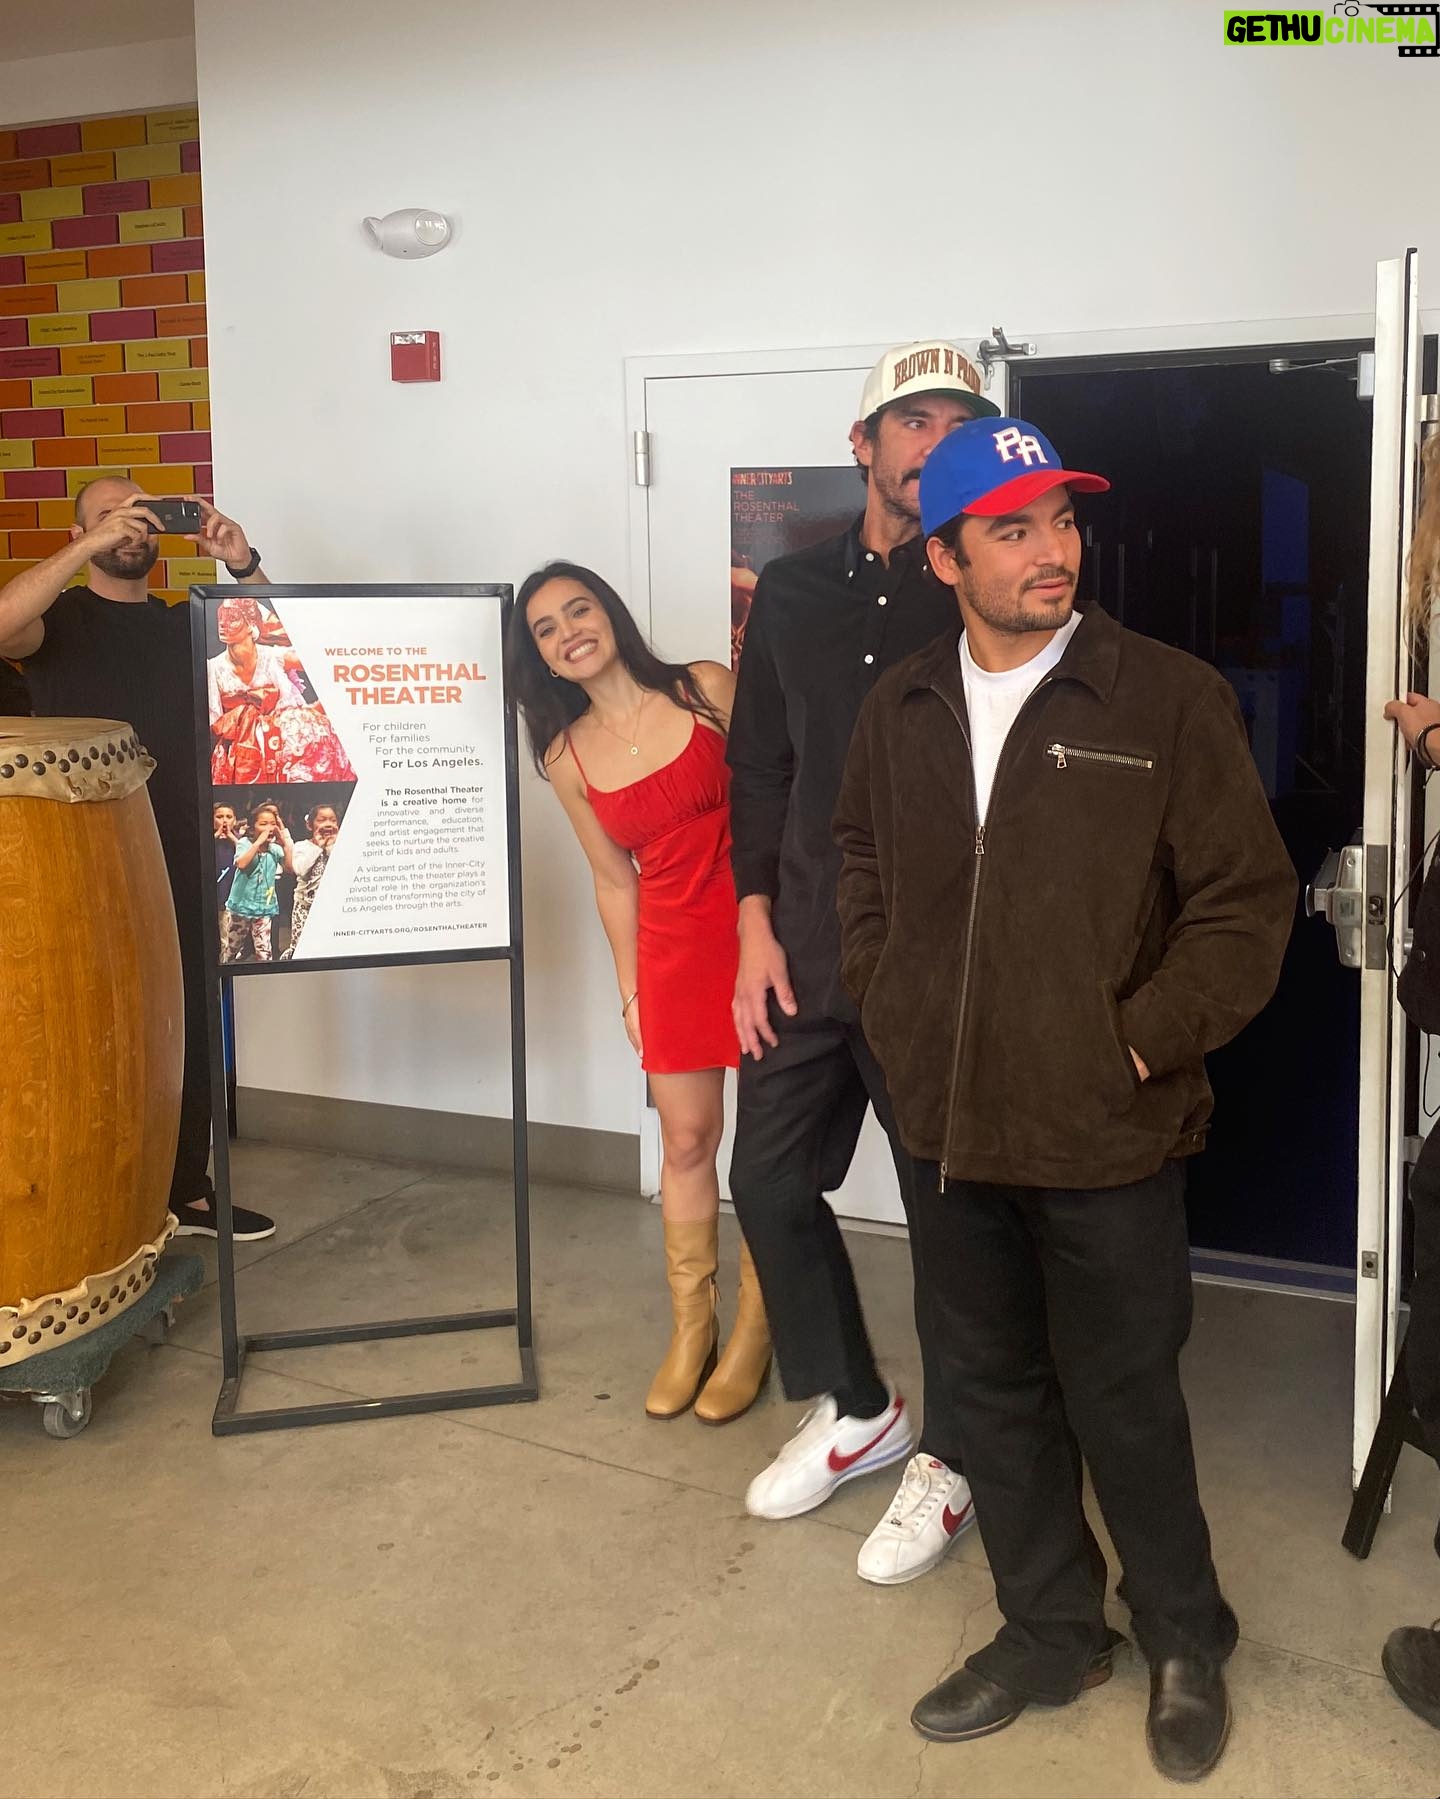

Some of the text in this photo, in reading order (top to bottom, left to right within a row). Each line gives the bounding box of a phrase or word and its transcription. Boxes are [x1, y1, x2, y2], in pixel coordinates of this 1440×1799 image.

[893, 348, 940, 391] BROWN
[944, 348, 954, 375] N
[992, 427, 1048, 466] PA
[733, 490, 755, 500] THE
[733, 500, 800, 512] ROSENTHAL
[733, 512, 784, 522] THEATER
[324, 647, 427, 656] WELCOME TO THE
[333, 663, 487, 682] ROSENTHAL
[346, 686, 462, 705] THEATER
[362, 722, 426, 731] For children
[369, 733, 430, 744] For families
[375, 744, 475, 756] For the community
[382, 757, 484, 769] For Los Angeles.
[385, 786, 484, 796] The Rosenthal Theater
[381, 799, 388, 807] is
[403, 798, 437, 806] creative
[377, 806, 484, 817] innovative and diverse
[370, 825, 484, 837] and artist engagement that
[366, 839, 389, 847] seeks
[437, 836, 450, 844] the
[452, 834, 485, 843] creative
[362, 848, 383, 857] spirit
[385, 848, 394, 856] of
[396, 847, 413, 855] kids
[415, 846, 431, 855] and
[366, 865, 395, 873] vibrant
[398, 864, 415, 873] part
[418, 862, 427, 871] of
[429, 862, 443, 870] the
[445, 860, 485, 869] Inner-City
[354, 875, 371, 883] Arts
[410, 873, 424, 881] the
[426, 871, 455, 880] theater
[457, 870, 478, 879] plays
[350, 879, 486, 894] pivotal role in the organization's
[346, 888, 486, 903] mission of transforming the city of
[342, 905, 357, 913] Los
[359, 903, 393, 913] Angeles
[395, 901, 428, 910] through
[430, 900, 443, 909] the
